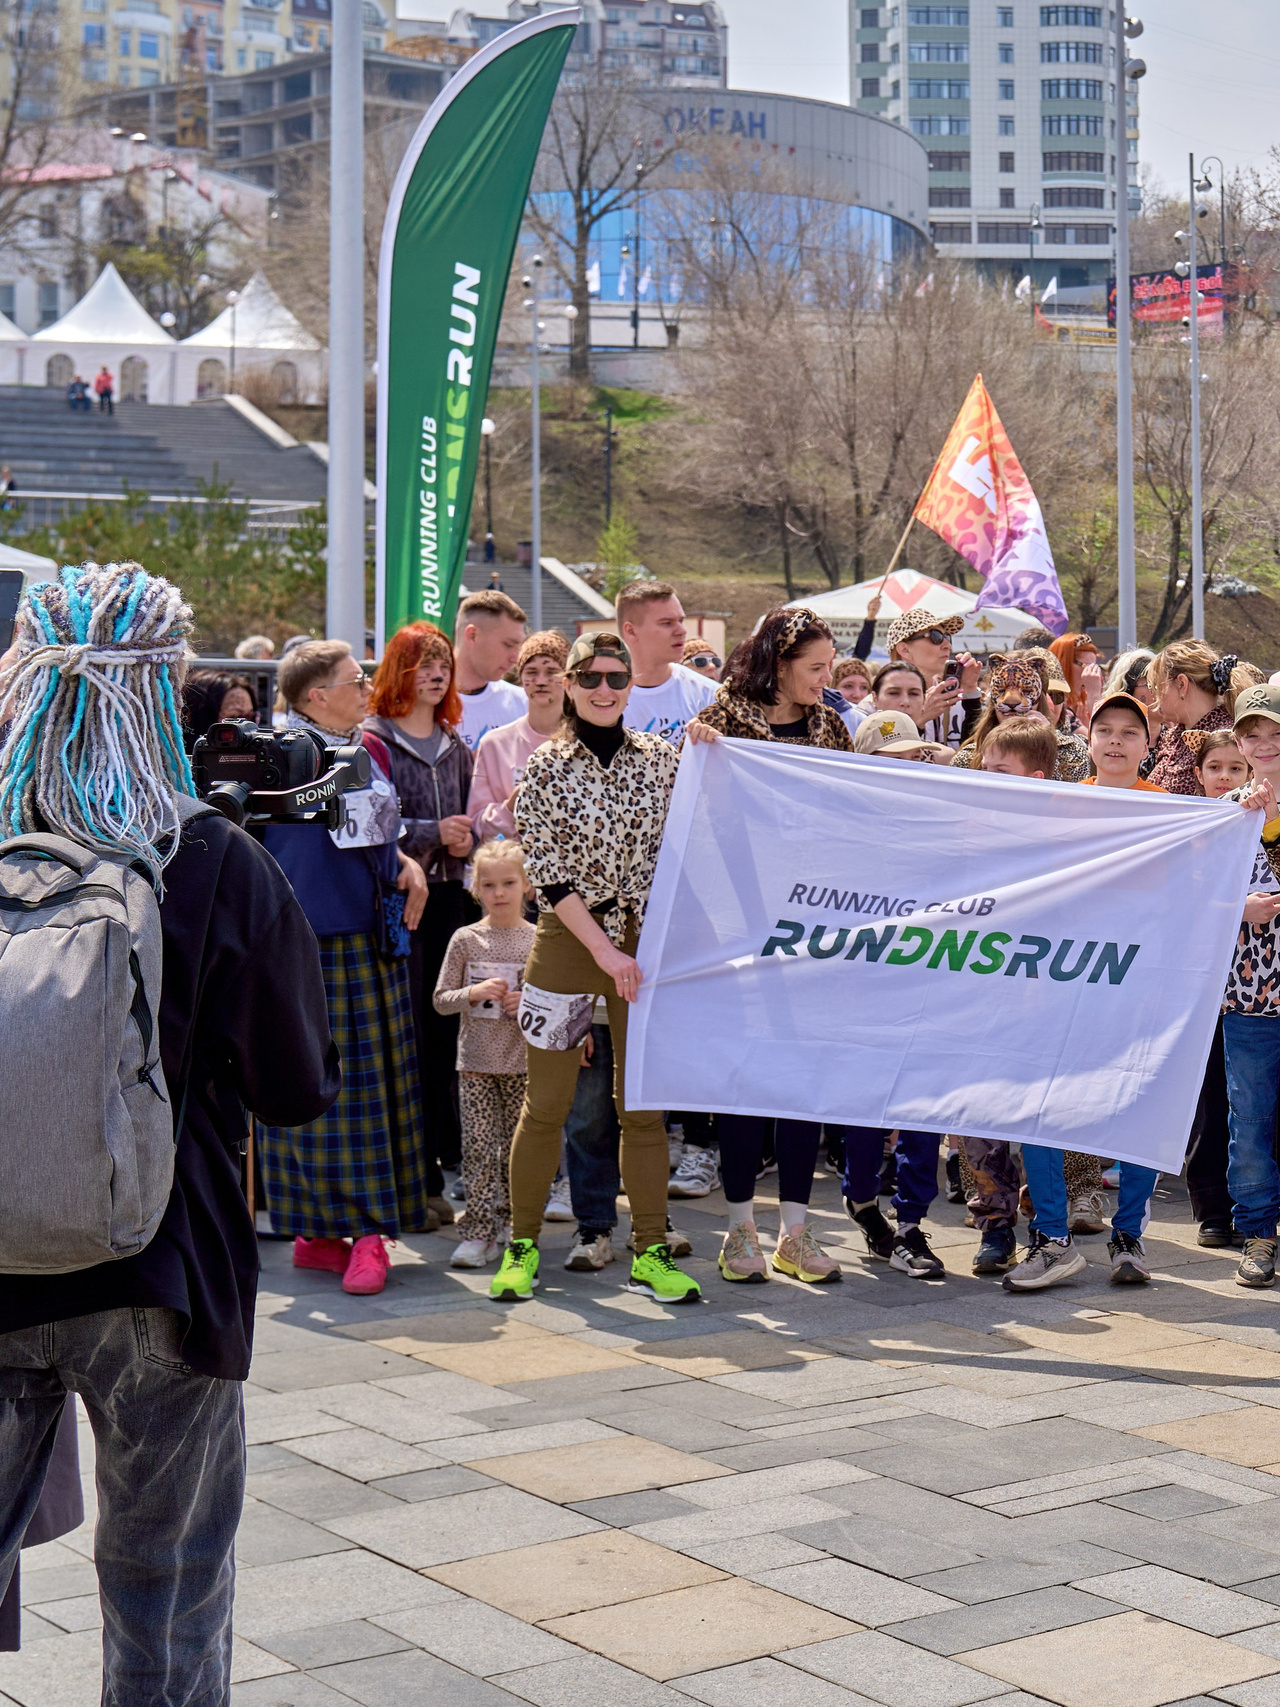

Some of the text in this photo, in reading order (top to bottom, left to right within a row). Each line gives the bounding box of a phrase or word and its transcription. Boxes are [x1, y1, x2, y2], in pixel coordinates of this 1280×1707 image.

[420, 416, 442, 618] RUNNING CLUB
[295, 779, 336, 807] RONIN
[787, 882, 997, 918] RUNNING CLUB
[760, 918, 1142, 986] RUNDNSRUN
[520, 1010, 548, 1037] 02
